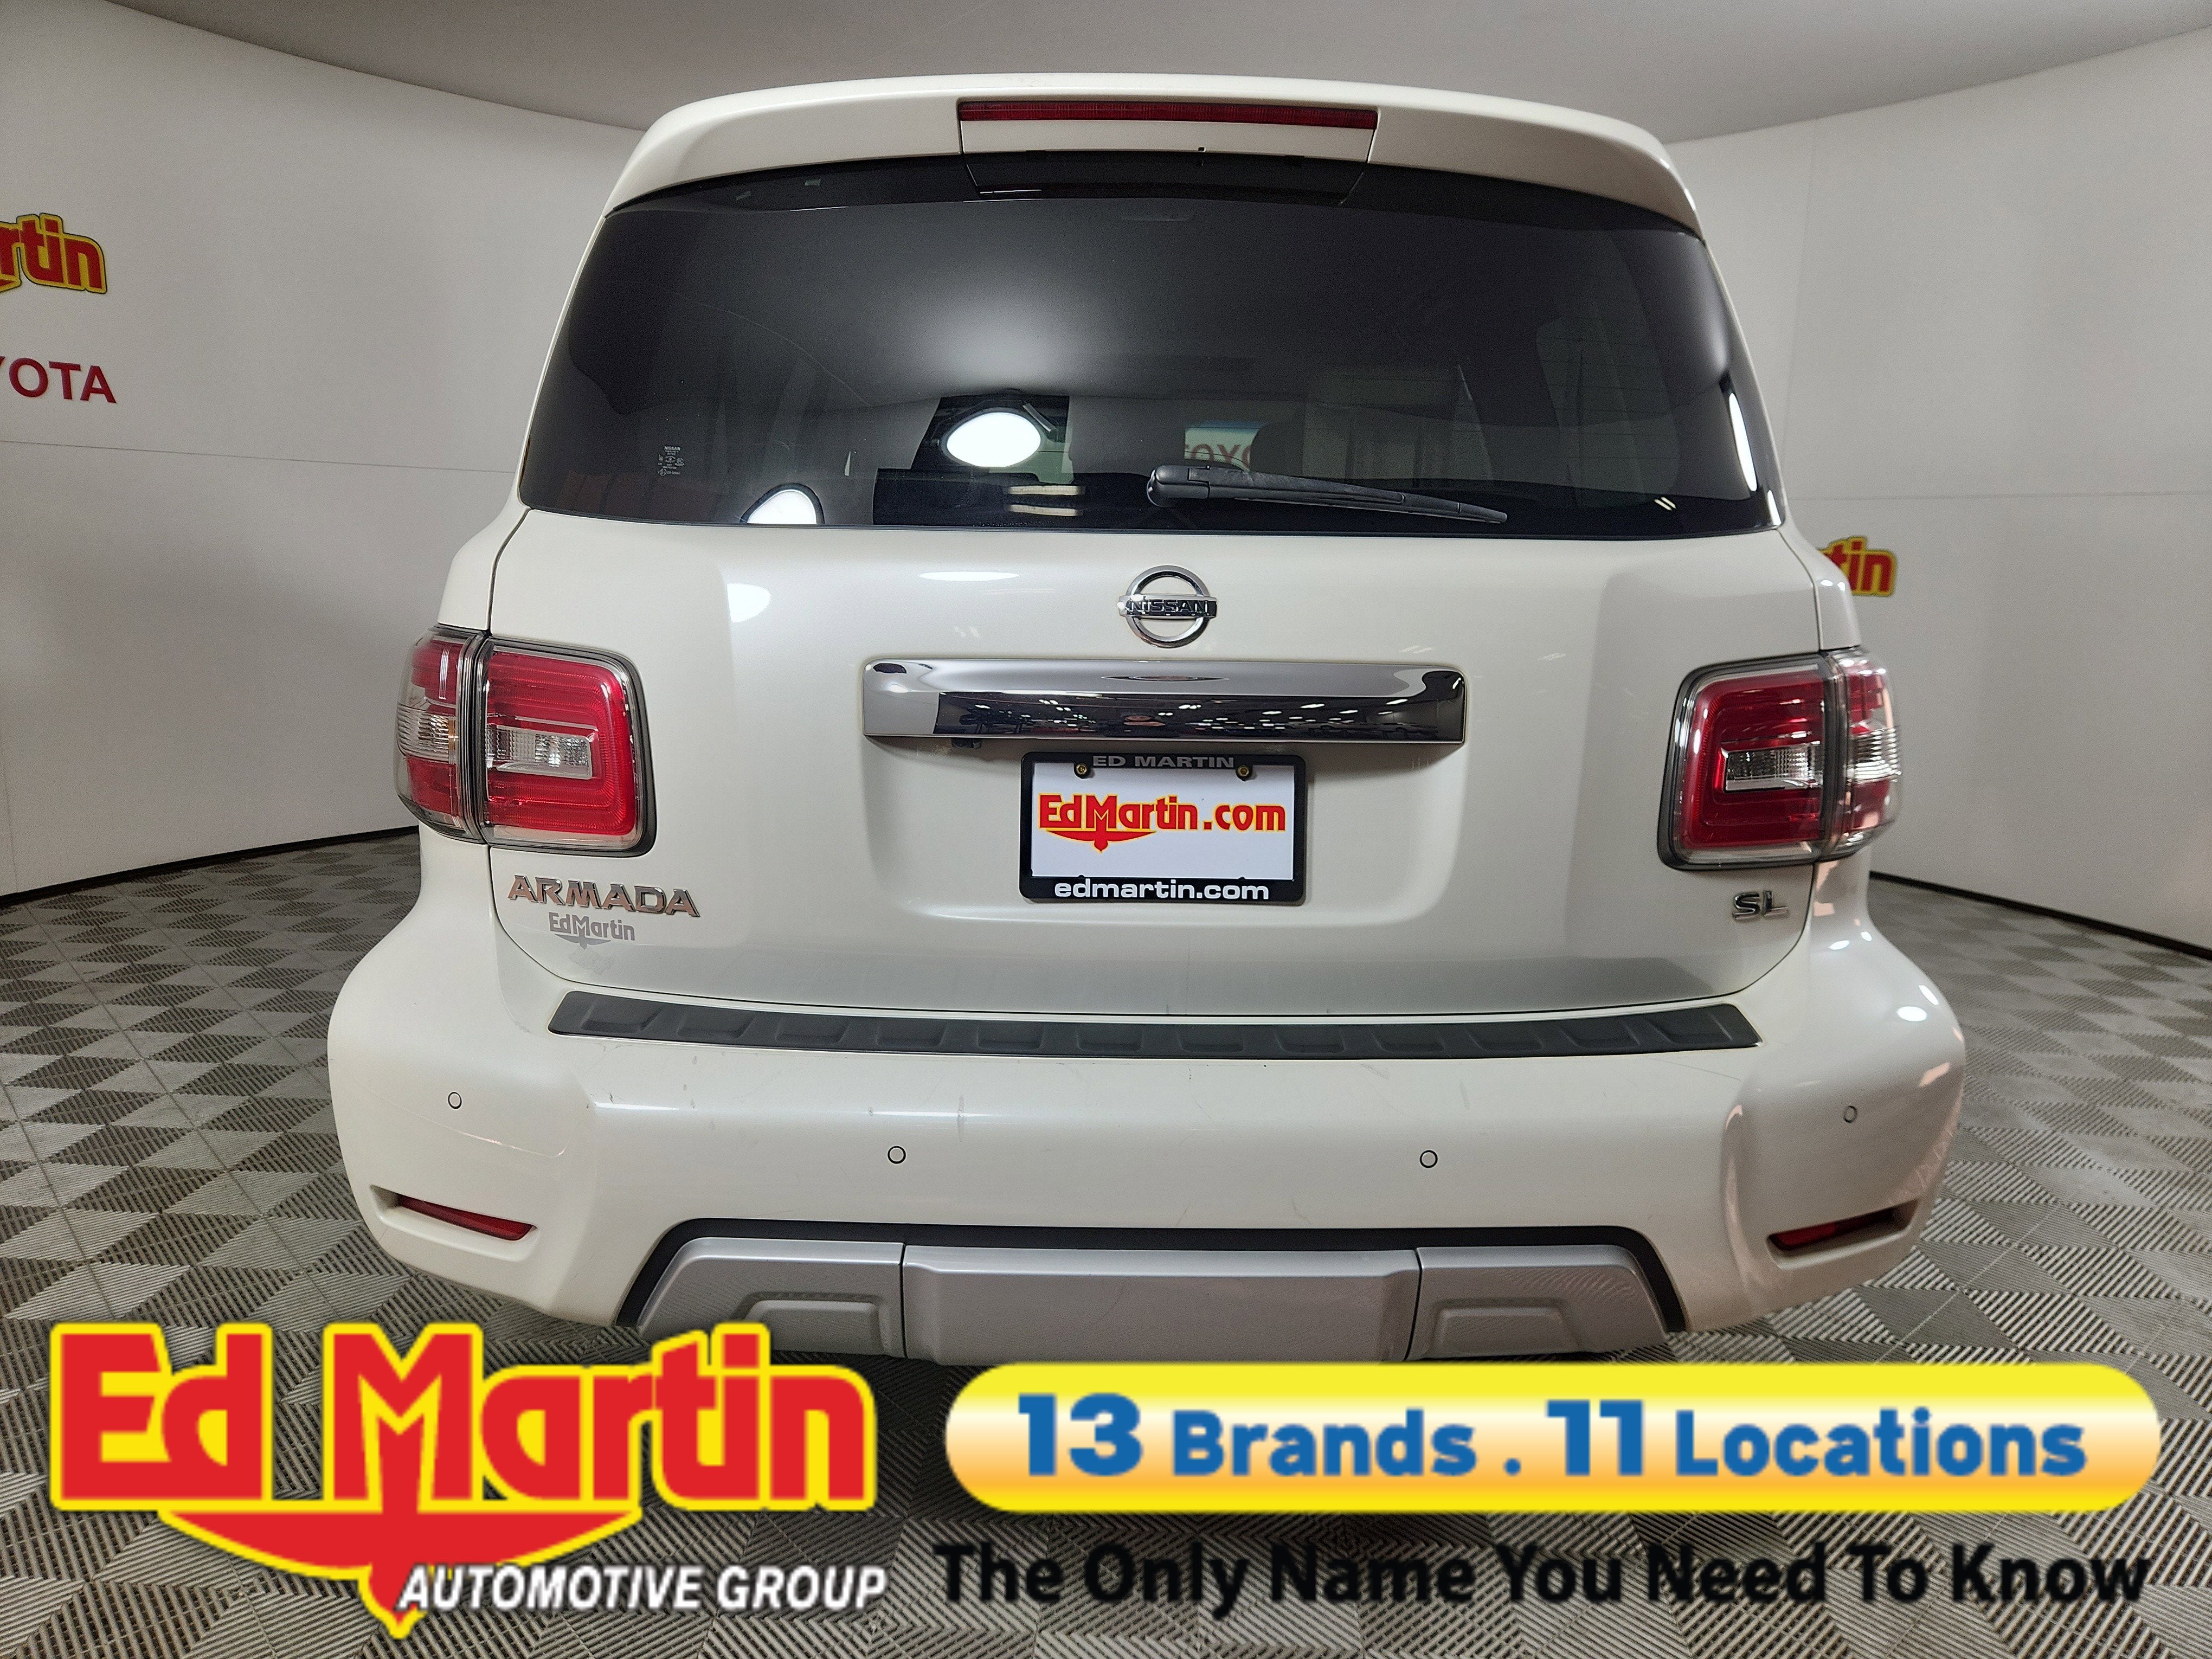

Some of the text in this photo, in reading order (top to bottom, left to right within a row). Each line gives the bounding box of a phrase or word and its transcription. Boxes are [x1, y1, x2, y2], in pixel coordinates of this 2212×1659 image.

[0, 356, 116, 403] OTA
[1126, 599, 1208, 613] NISSAN
[1092, 756, 1234, 768] ED MARTIN
[507, 874, 700, 917] ARMADA
[1054, 878, 1269, 900] edmartin.com
[1732, 890, 1789, 921] SL
